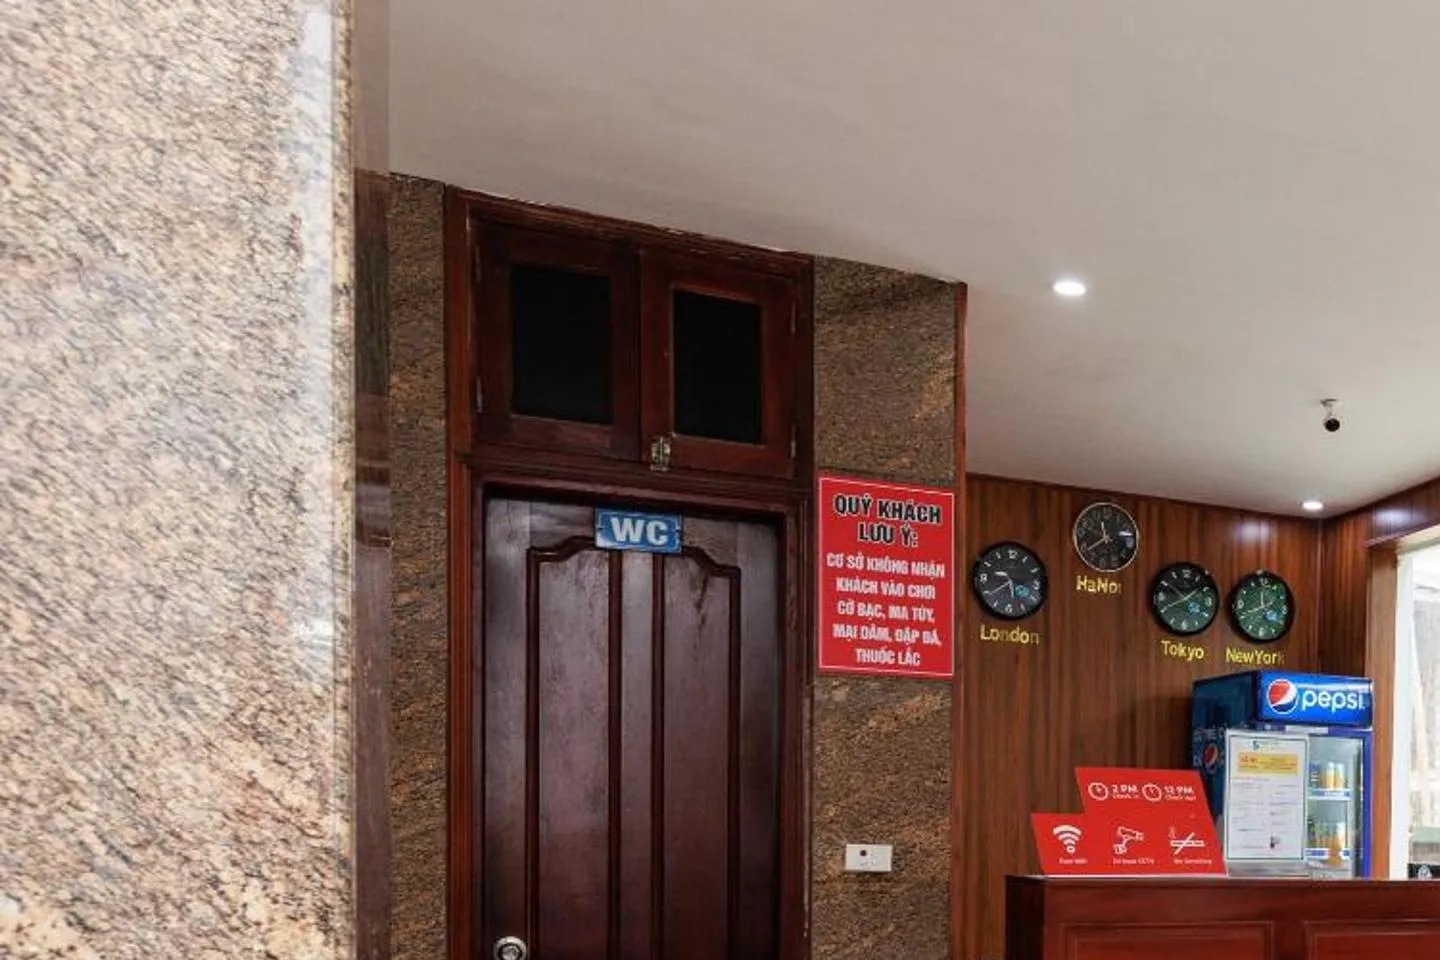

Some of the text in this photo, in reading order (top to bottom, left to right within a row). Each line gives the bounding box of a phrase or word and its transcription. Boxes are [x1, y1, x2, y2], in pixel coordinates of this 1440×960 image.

[833, 493, 943, 524] QUÝ KHÁCH
[610, 517, 668, 546] WC
[858, 521, 896, 545] LƯU
[826, 551, 945, 580] CƠ SỞ KHÔNG NHẬN
[836, 576, 936, 599] KHÁCH VÀO CHƠI
[857, 602, 886, 620] BẠC,
[888, 606, 909, 619] MA
[980, 623, 1040, 645] London
[855, 645, 895, 665] THUỐC
[1161, 640, 1205, 661] Tokyo
[1225, 647, 1285, 665] NewYork
[1301, 690, 1364, 714] pepsi
